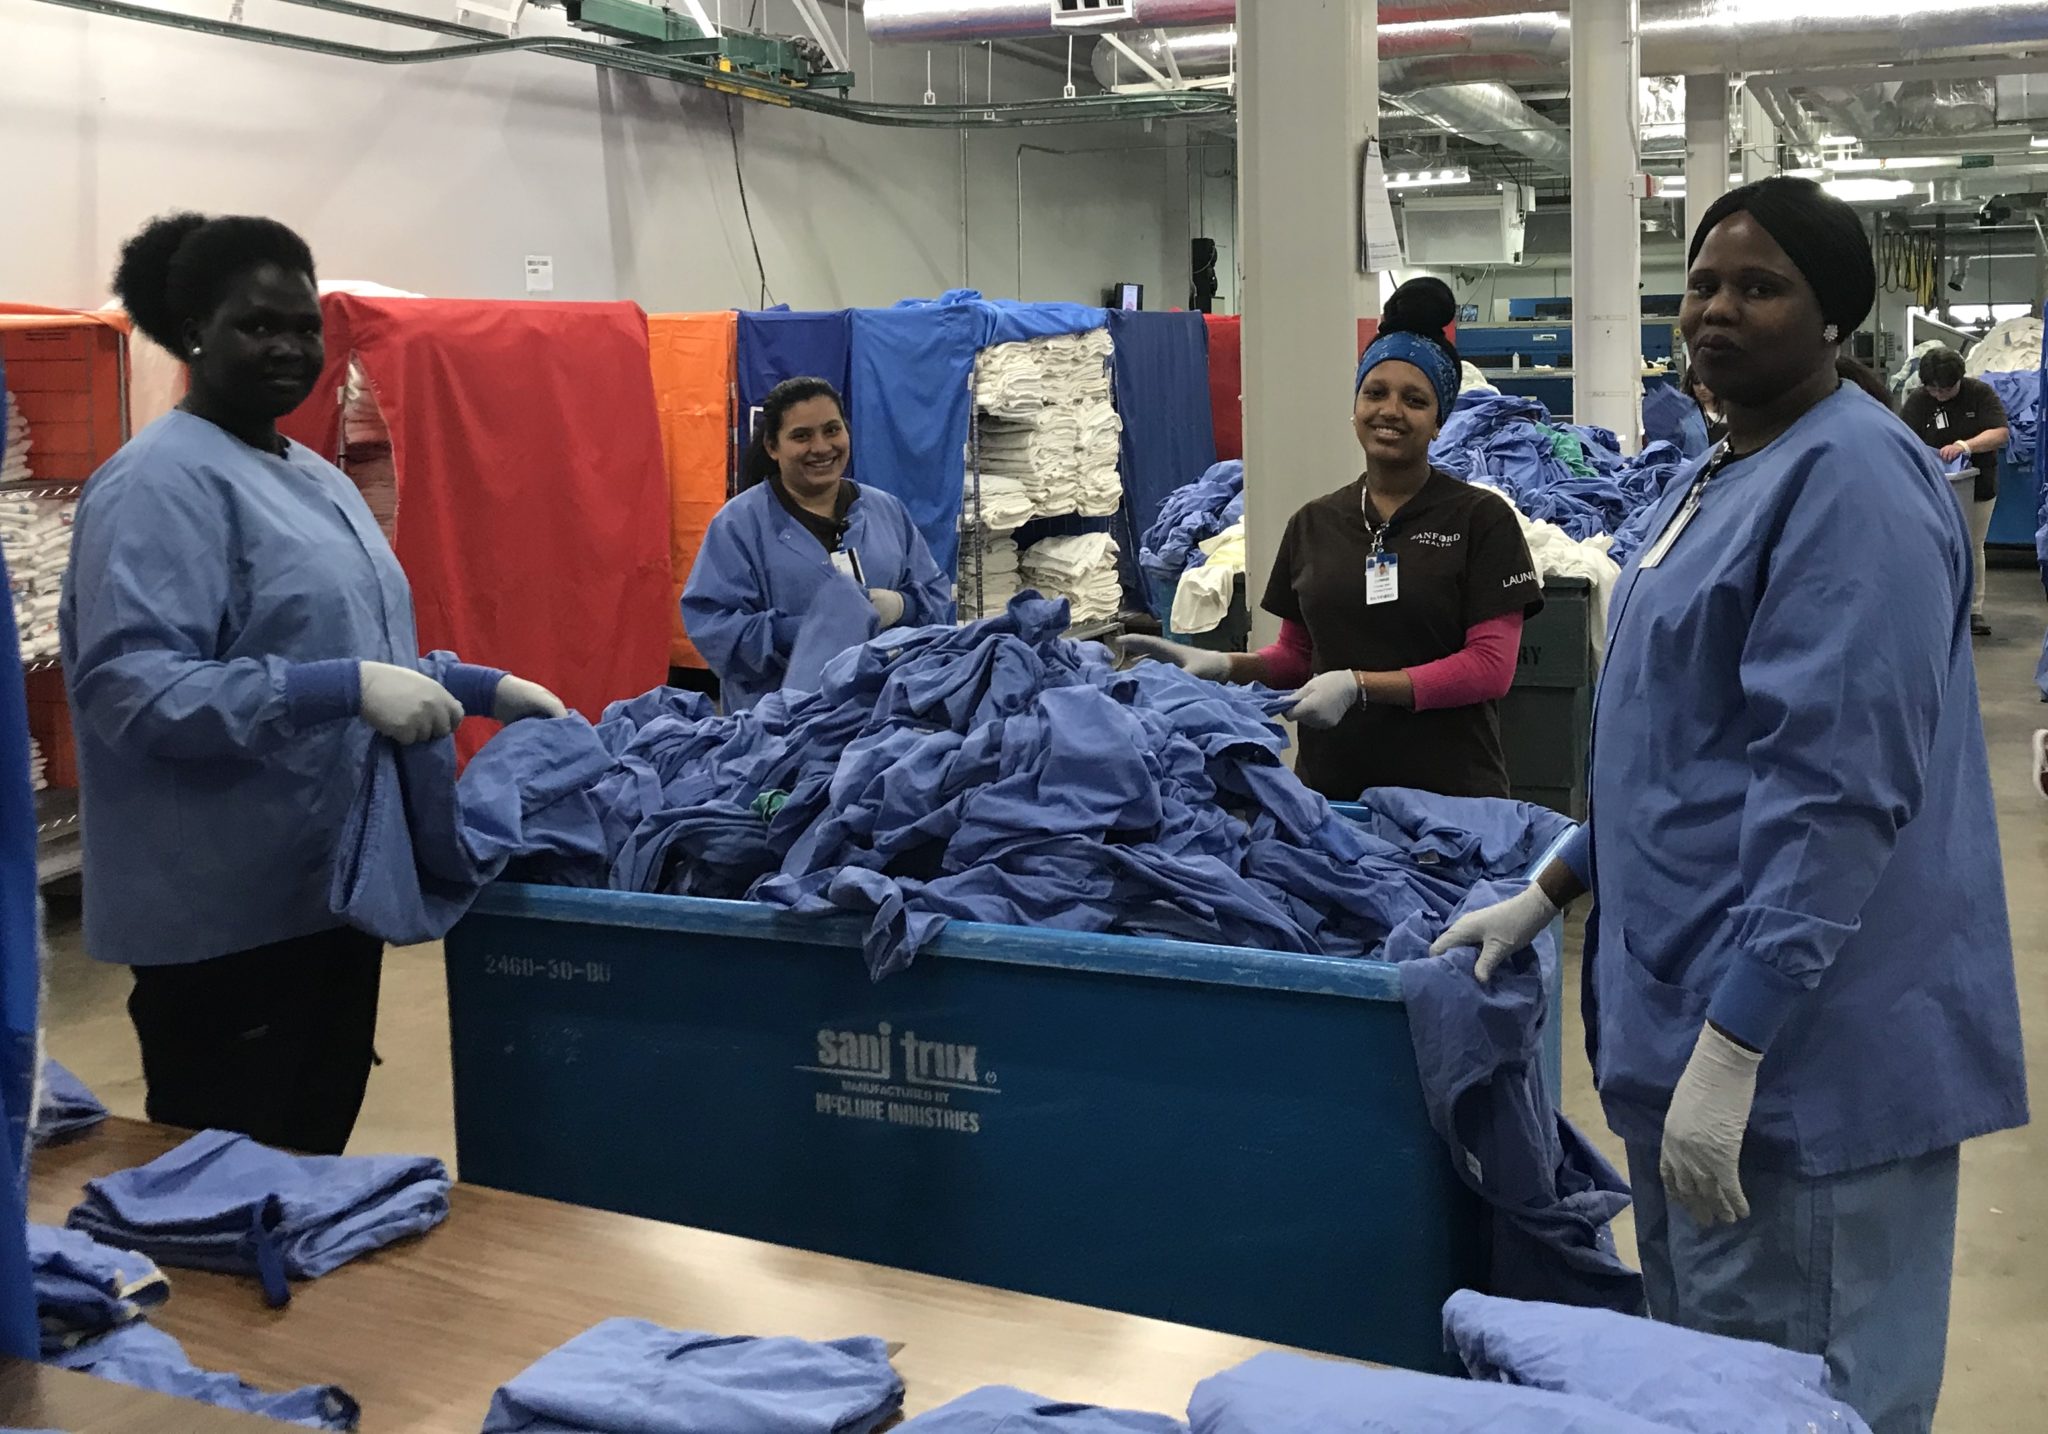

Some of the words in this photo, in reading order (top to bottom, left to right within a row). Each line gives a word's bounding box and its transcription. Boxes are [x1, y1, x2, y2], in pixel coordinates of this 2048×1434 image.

[1419, 539, 1452, 548] HEALTH
[900, 1030, 979, 1084] trux
[888, 1101, 981, 1134] INDUSTRIES
